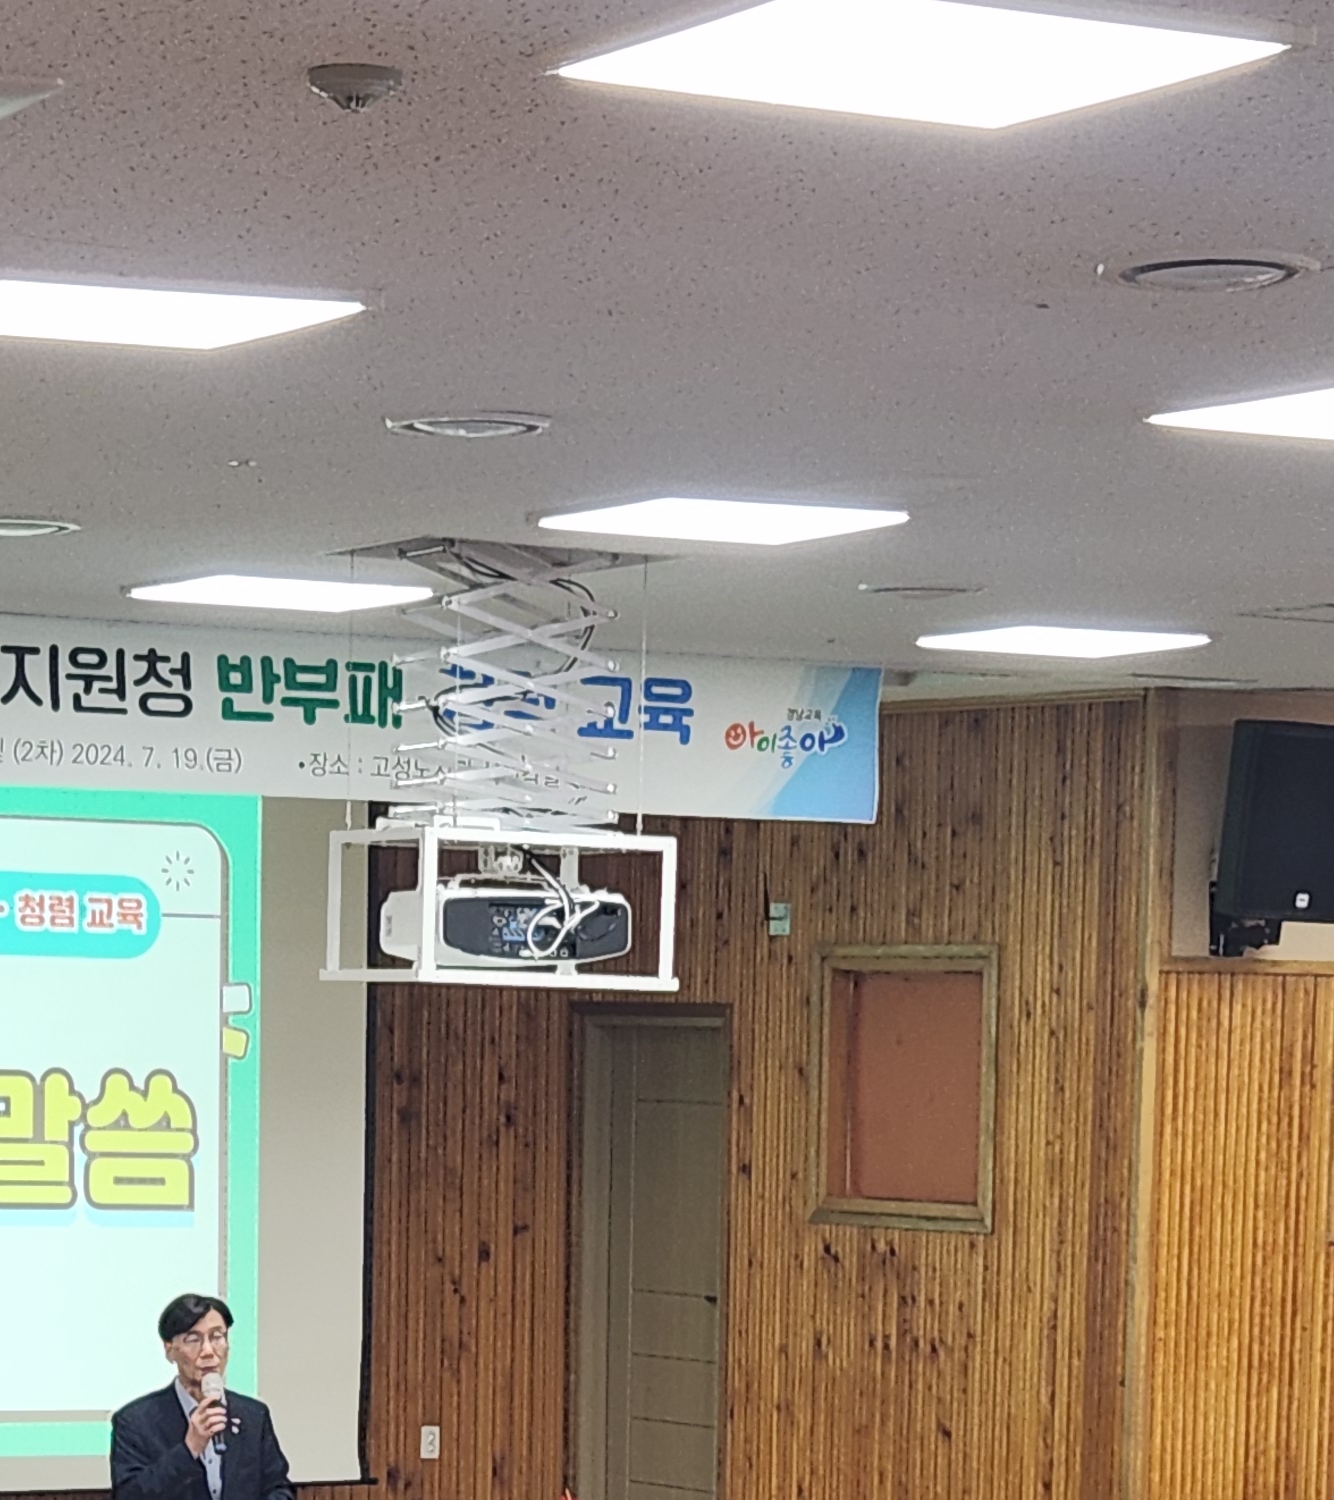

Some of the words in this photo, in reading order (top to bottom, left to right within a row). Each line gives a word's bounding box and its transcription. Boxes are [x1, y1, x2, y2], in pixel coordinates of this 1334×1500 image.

[577, 675, 694, 746] 교육
[13, 737, 64, 766] (2차)
[71, 742, 133, 768] 2024.
[141, 745, 162, 769] 7.
[724, 720, 846, 770] 아이좋아
[309, 751, 350, 777] 장소
[84, 895, 146, 931] 교육
